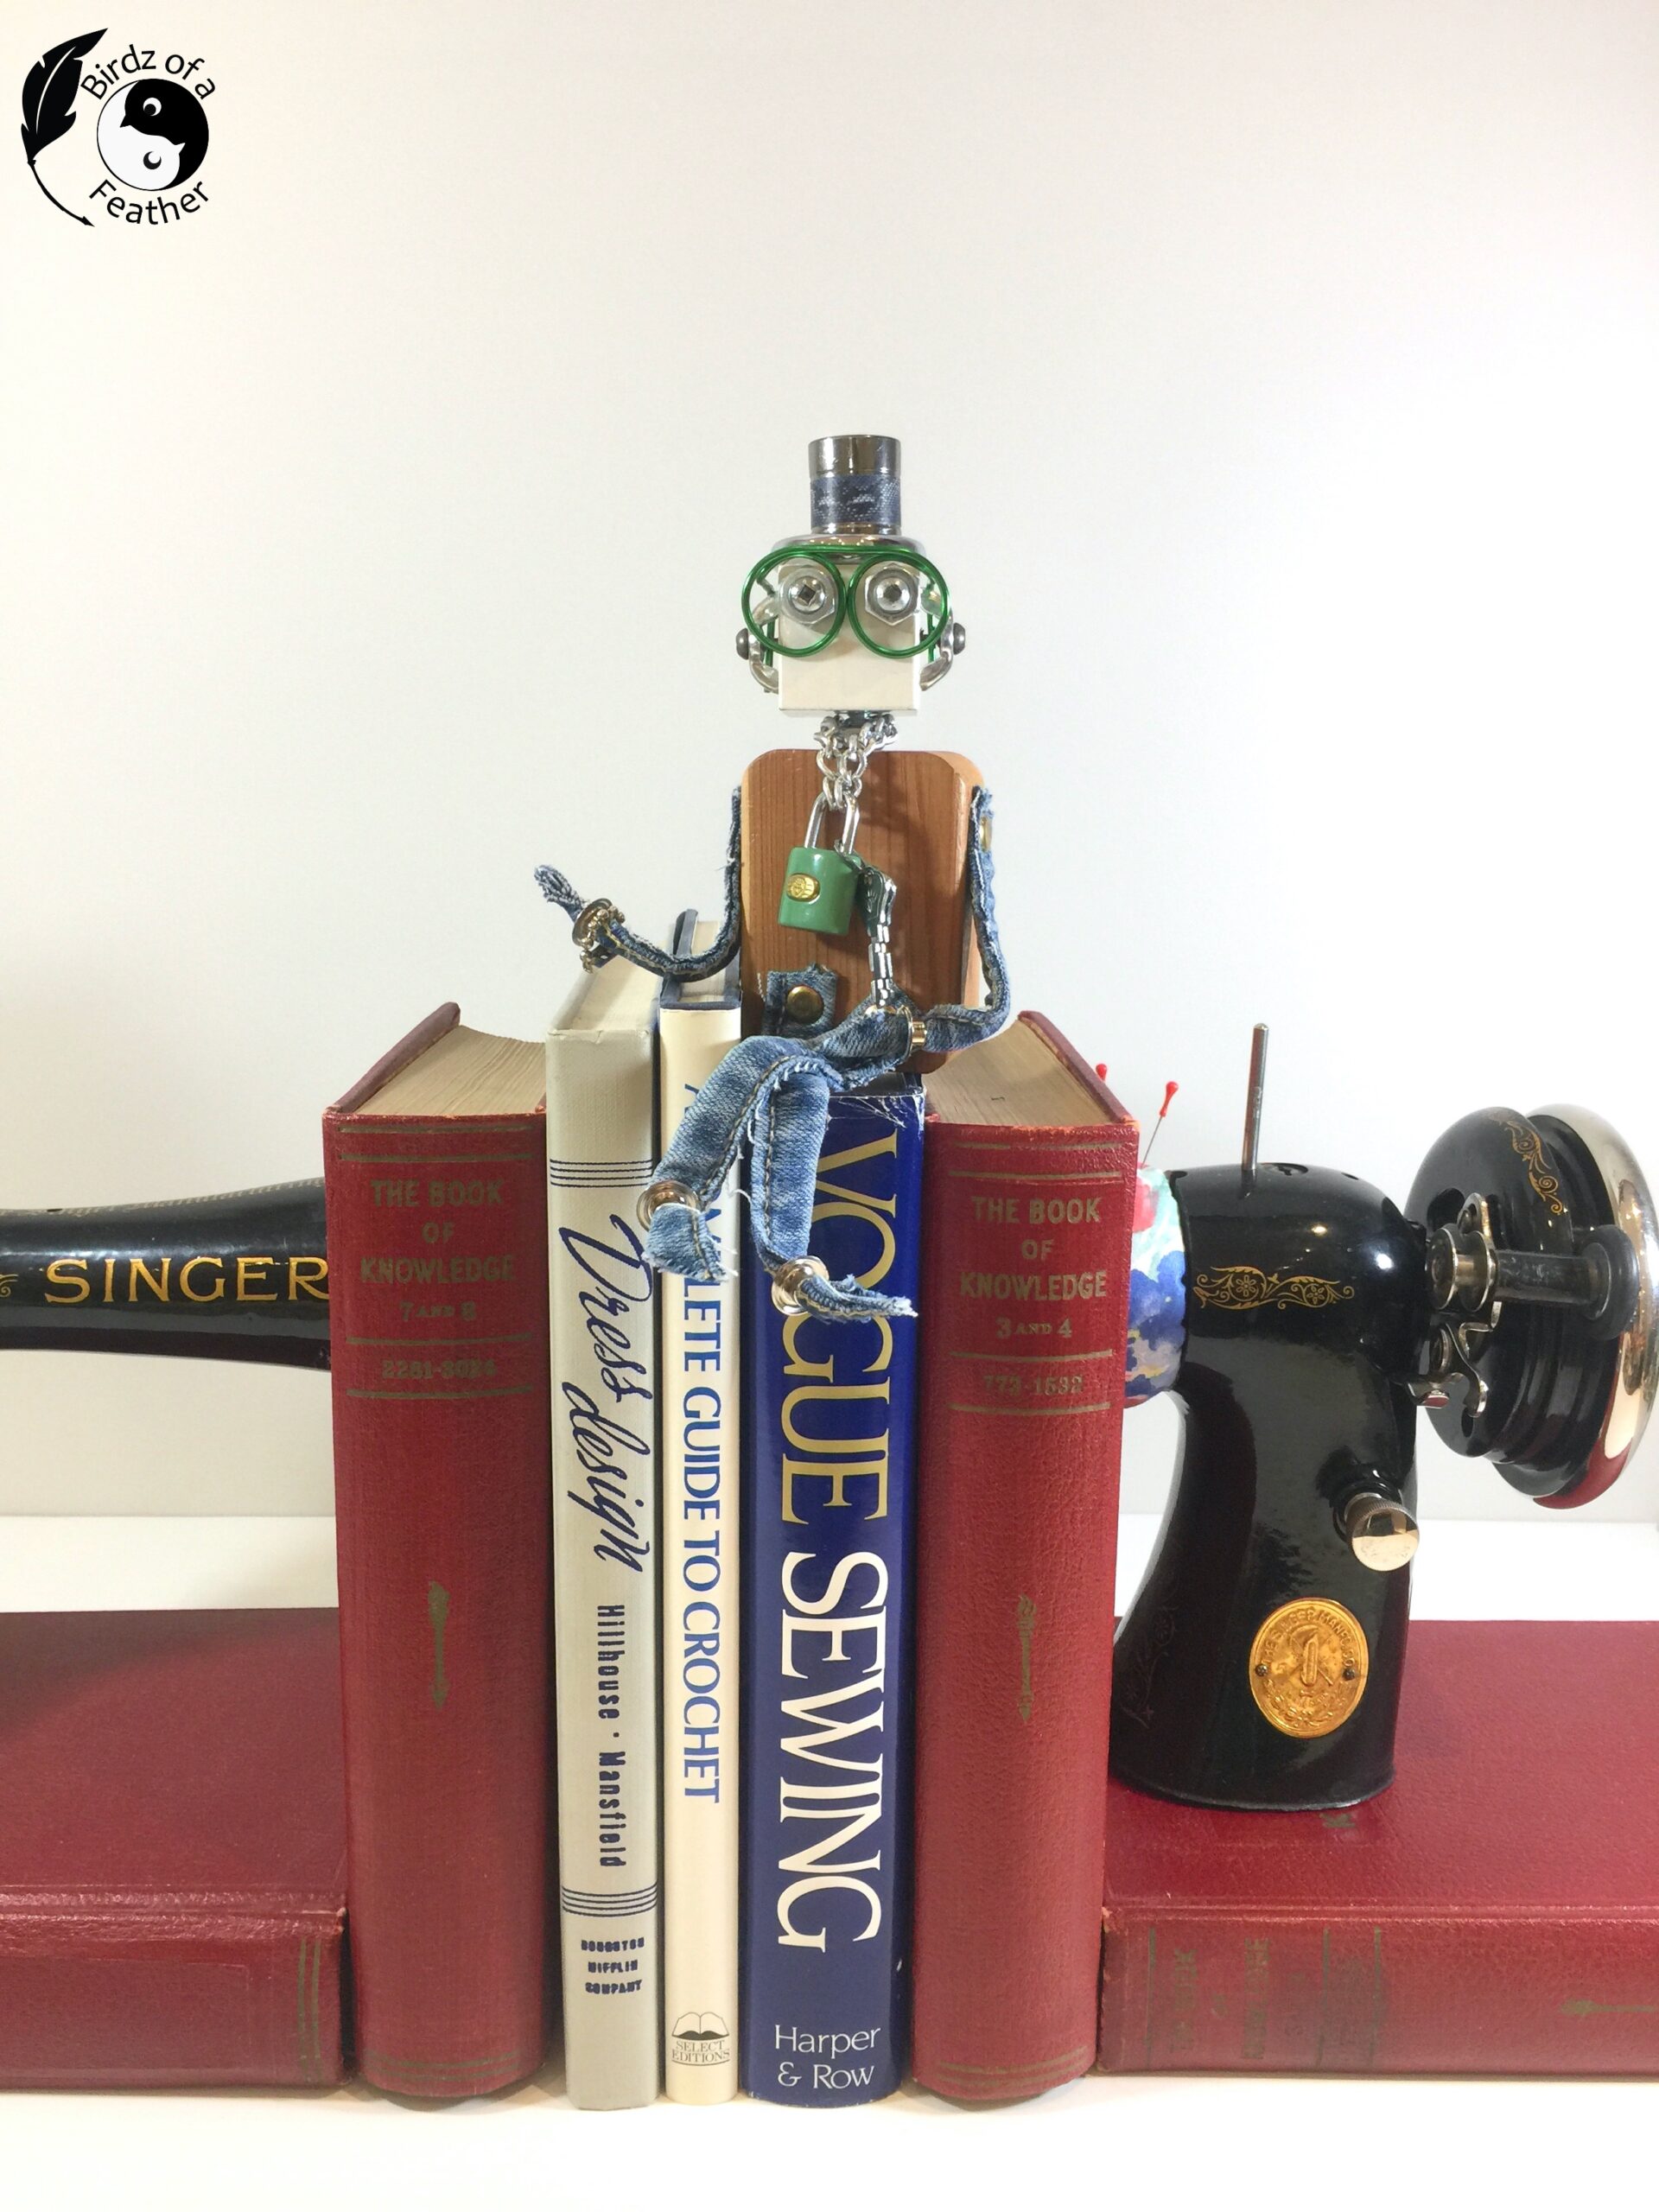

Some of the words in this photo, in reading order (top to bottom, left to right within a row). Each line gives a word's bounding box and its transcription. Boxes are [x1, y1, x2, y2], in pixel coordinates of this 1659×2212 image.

[370, 1179, 420, 1207] THE
[429, 1178, 504, 1207] BOOK
[971, 1196, 1020, 1224] THE
[1029, 1197, 1102, 1224] BOOK
[422, 1221, 455, 1244] OF
[1021, 1239, 1055, 1261] OF
[45, 1255, 329, 1302] SINGER
[360, 1254, 517, 1285] KNOWLEDGE
[960, 1270, 1107, 1301] KNOWLEDGE
[400, 1300, 414, 1322] 7
[558, 1213, 653, 1403] Dress
[782, 1129, 898, 1525] VOGUE
[995, 1317, 1012, 1339] 3
[1015, 1322, 1053, 1337] AND
[1057, 1318, 1072, 1339] 4
[683, 1386, 721, 1521] GUIDE
[562, 1381, 652, 1573] design
[683, 1535, 721, 1592] TO
[597, 1604, 625, 1720] Hillhouse
[683, 1604, 721, 1804] CROCHET
[778, 1550, 889, 1954] SEWING
[598, 1751, 626, 1867] Mansfield
[588, 1959, 639, 1974] MIFFLIN
[585, 1980, 643, 1995] COMPANY
[671, 2049, 730, 2063] EDITIONS
[676, 2040, 725, 2052] SELECT
[775, 2024, 880, 2058] Harper
[778, 2063, 803, 2088] &
[812, 2063, 875, 2089] Row
